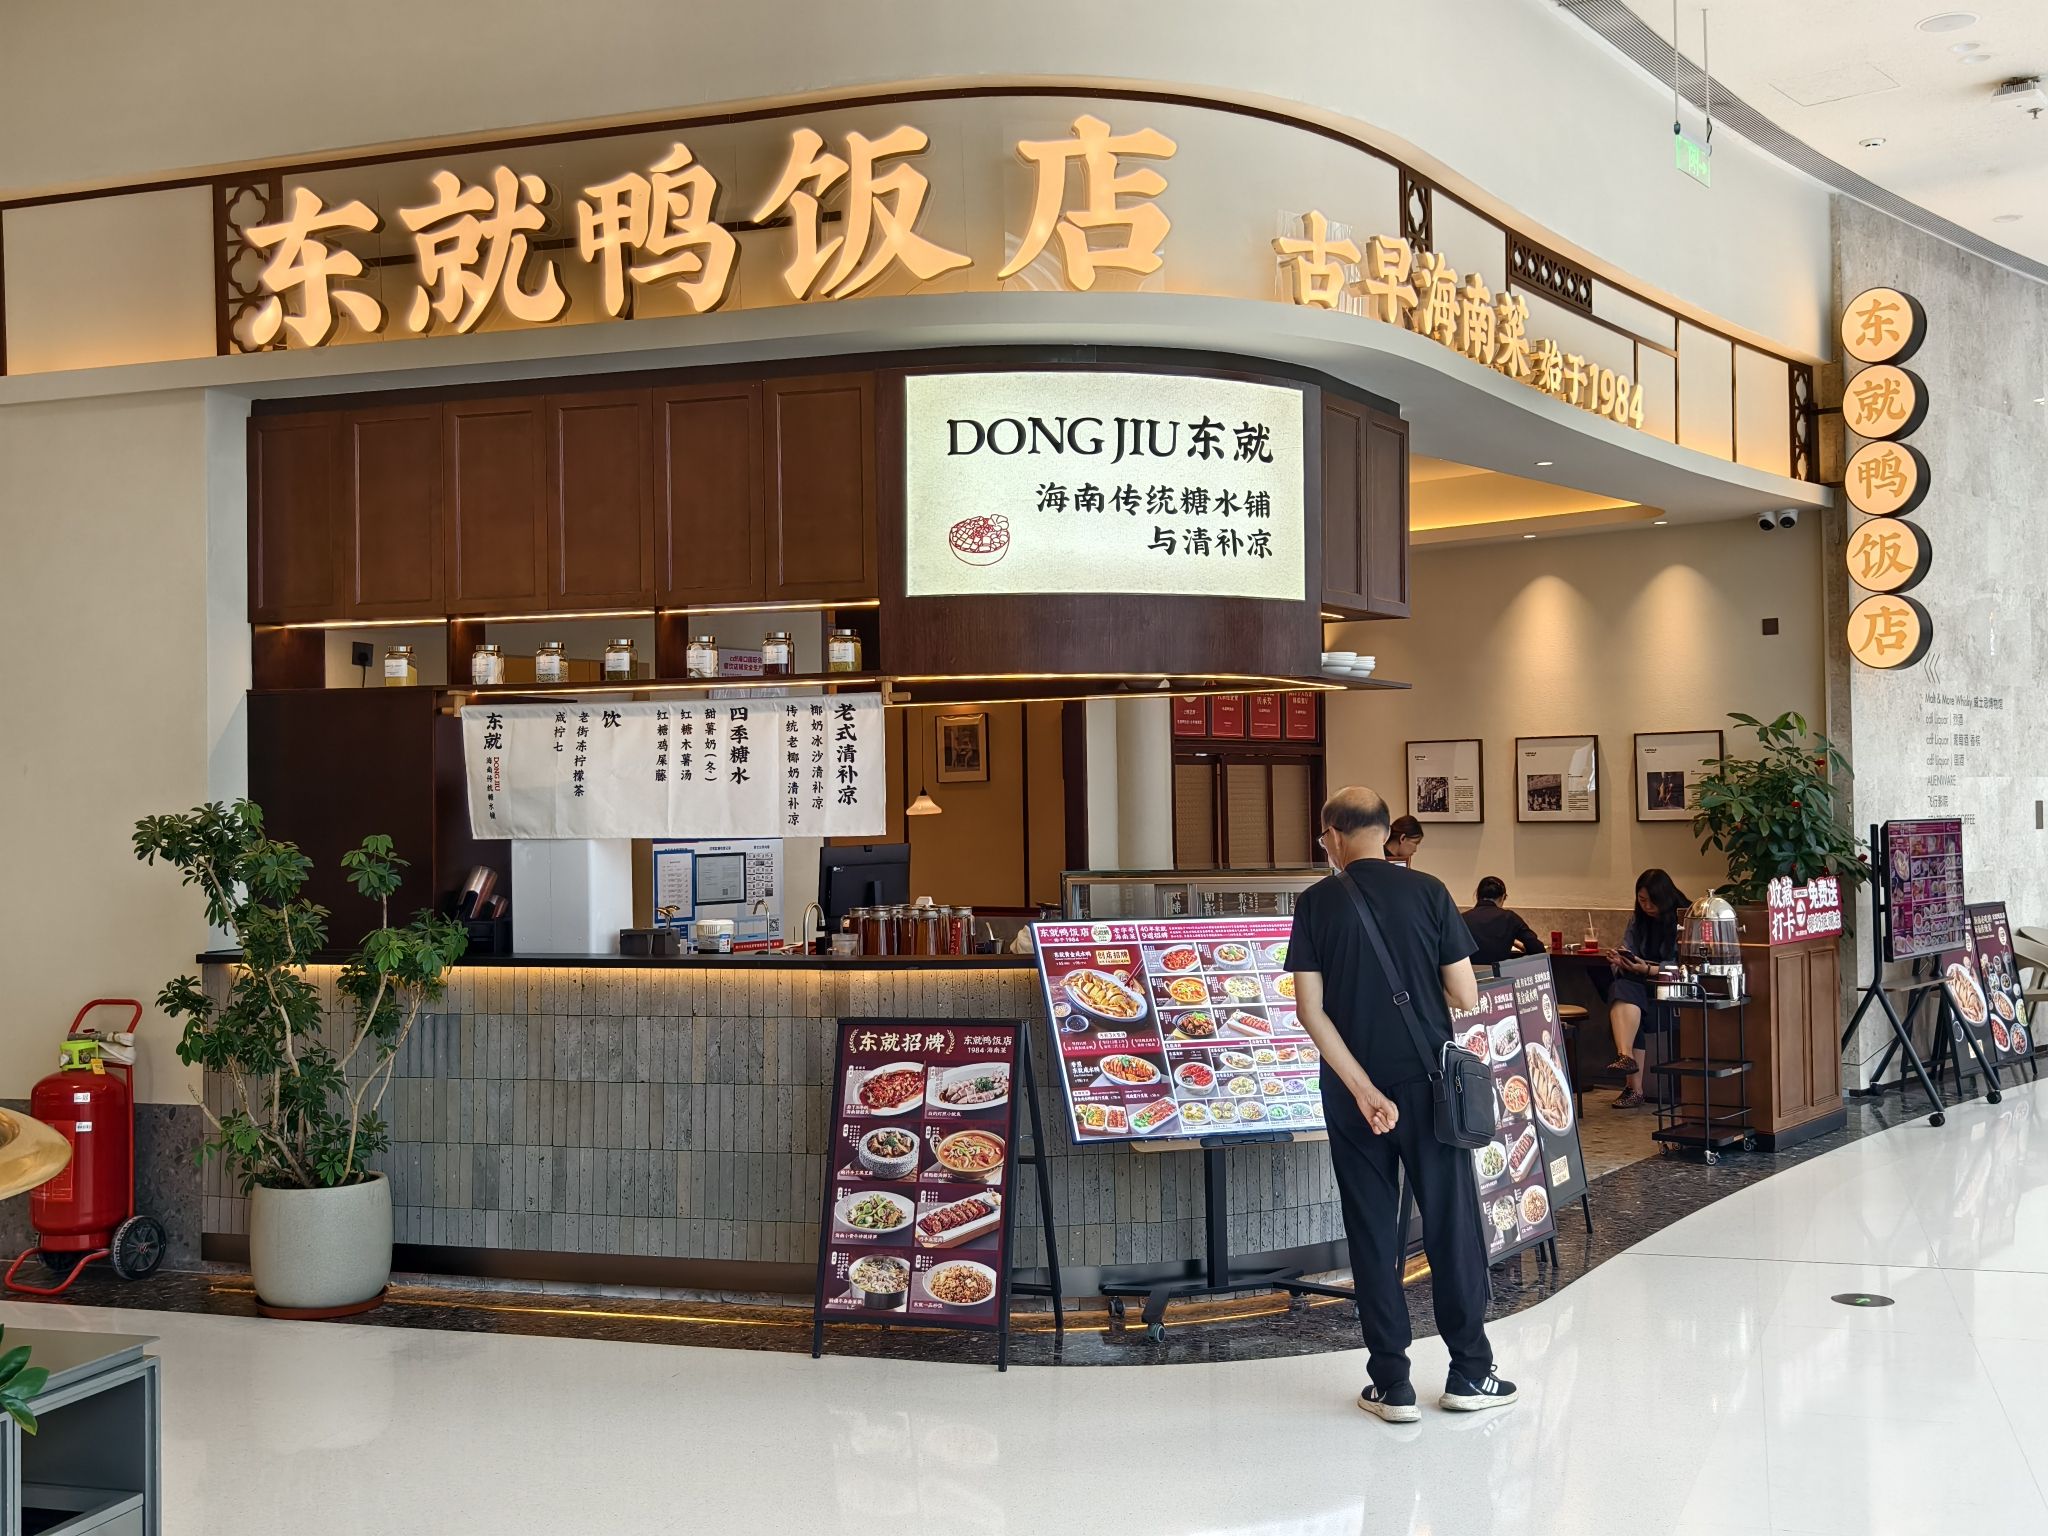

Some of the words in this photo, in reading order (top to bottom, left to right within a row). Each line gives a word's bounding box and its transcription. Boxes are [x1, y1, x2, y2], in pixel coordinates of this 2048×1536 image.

[246, 114, 1178, 347] 东就鸭饭店
[1271, 209, 1531, 378] 古早海南菜
[1532, 338, 1645, 430] 始于1984
[946, 416, 1105, 456] DONG
[1110, 417, 1180, 464] JIU
[1186, 415, 1275, 464] 东就
[1035, 482, 1272, 518] 海南传统糖水铺
[1852, 299, 1913, 658] 东就鸭饭店
[1147, 526, 1273, 559] 与清补凉
[484, 712, 503, 750] 东就
[573, 711, 591, 797] 老街冻柠檬茶
[602, 710, 622, 729] 饮
[655, 709, 669, 782] 红糖鸡屎藤
[680, 709, 693, 781] 红糖木薯汤
[729, 706, 751, 785] 四季糖水
[834, 703, 859, 806] 老式清补凉
[493, 757, 501, 780] DONG
[785, 704, 800, 826] 传统老椰奶清补凉
[810, 704, 824, 810] 椰奶冰沙清补凉
[859, 1032, 946, 1053] 东就招牌
[963, 1035, 1013, 1046] 东就鸭饭店
